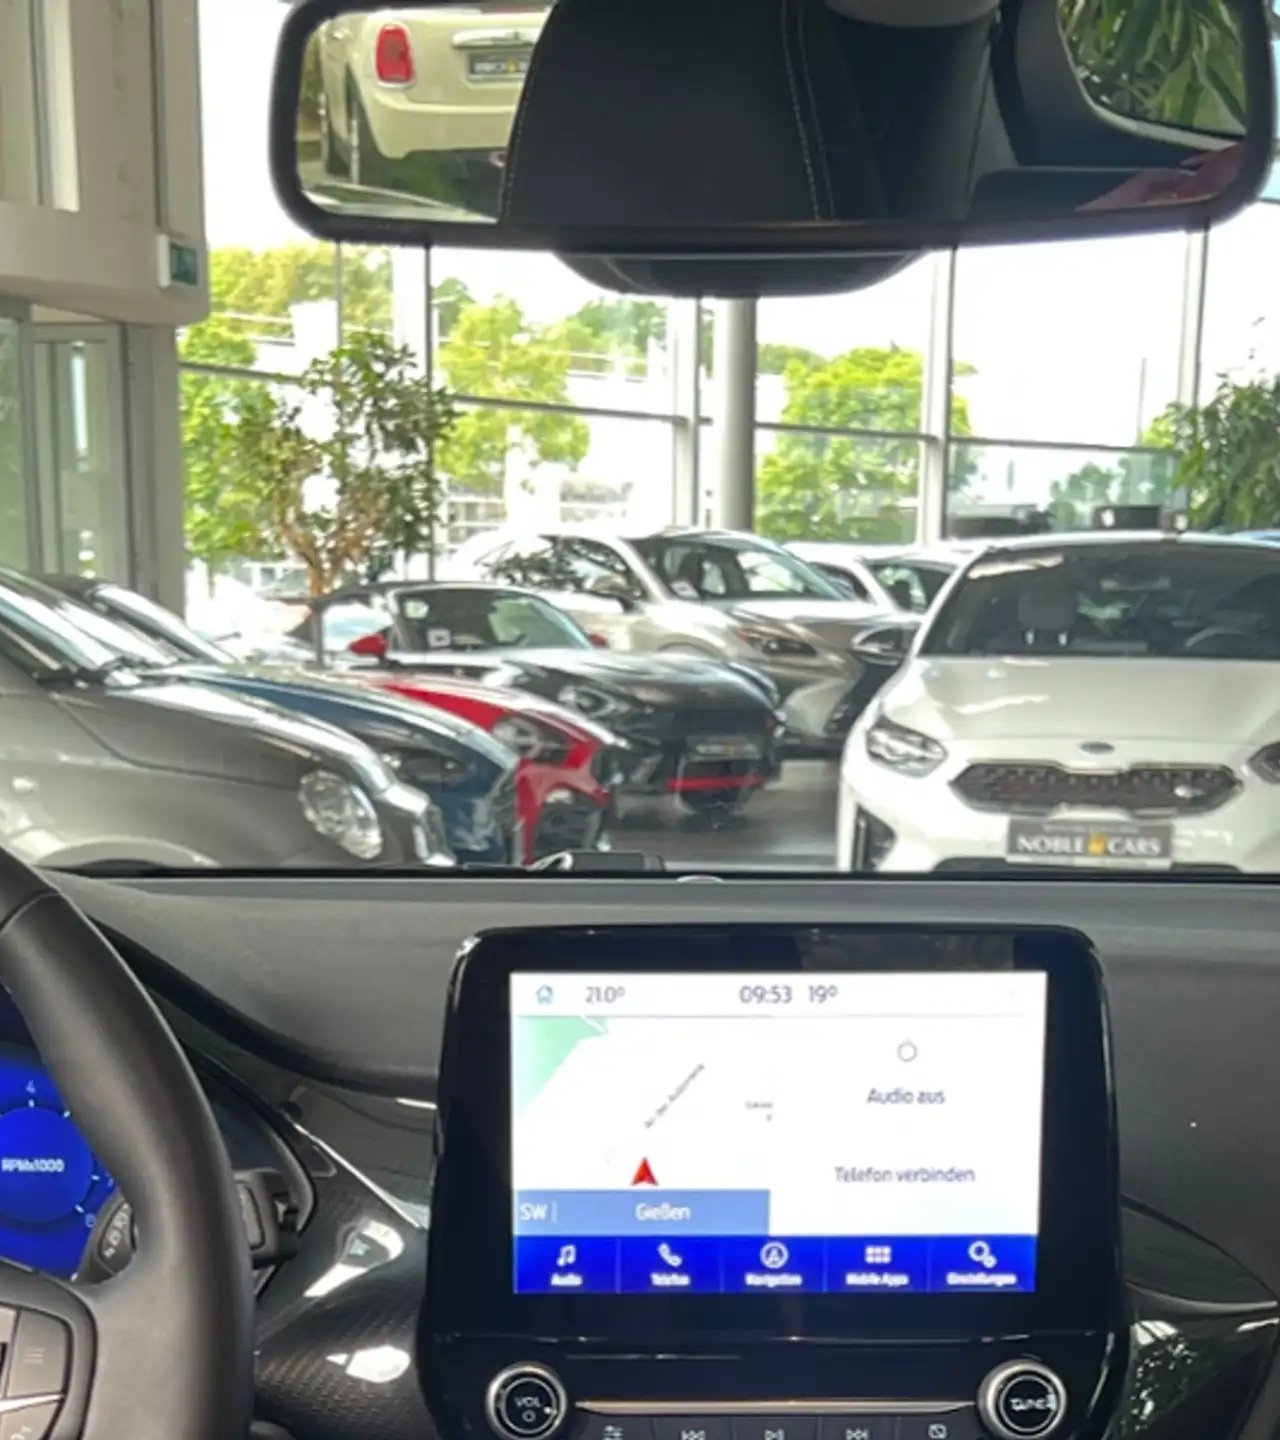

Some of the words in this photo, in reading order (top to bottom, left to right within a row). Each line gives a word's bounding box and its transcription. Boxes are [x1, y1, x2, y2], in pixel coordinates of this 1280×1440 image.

[1017, 835, 1086, 855] NOBLE
[1107, 836, 1161, 855] CARS
[738, 984, 793, 1005] 09:53
[866, 1087, 914, 1105] Audio
[917, 1090, 946, 1105] aus
[834, 1166, 892, 1183] Telefon
[896, 1166, 976, 1183] verbinden
[519, 1203, 548, 1221] SW
[635, 1202, 691, 1221] Gießen
